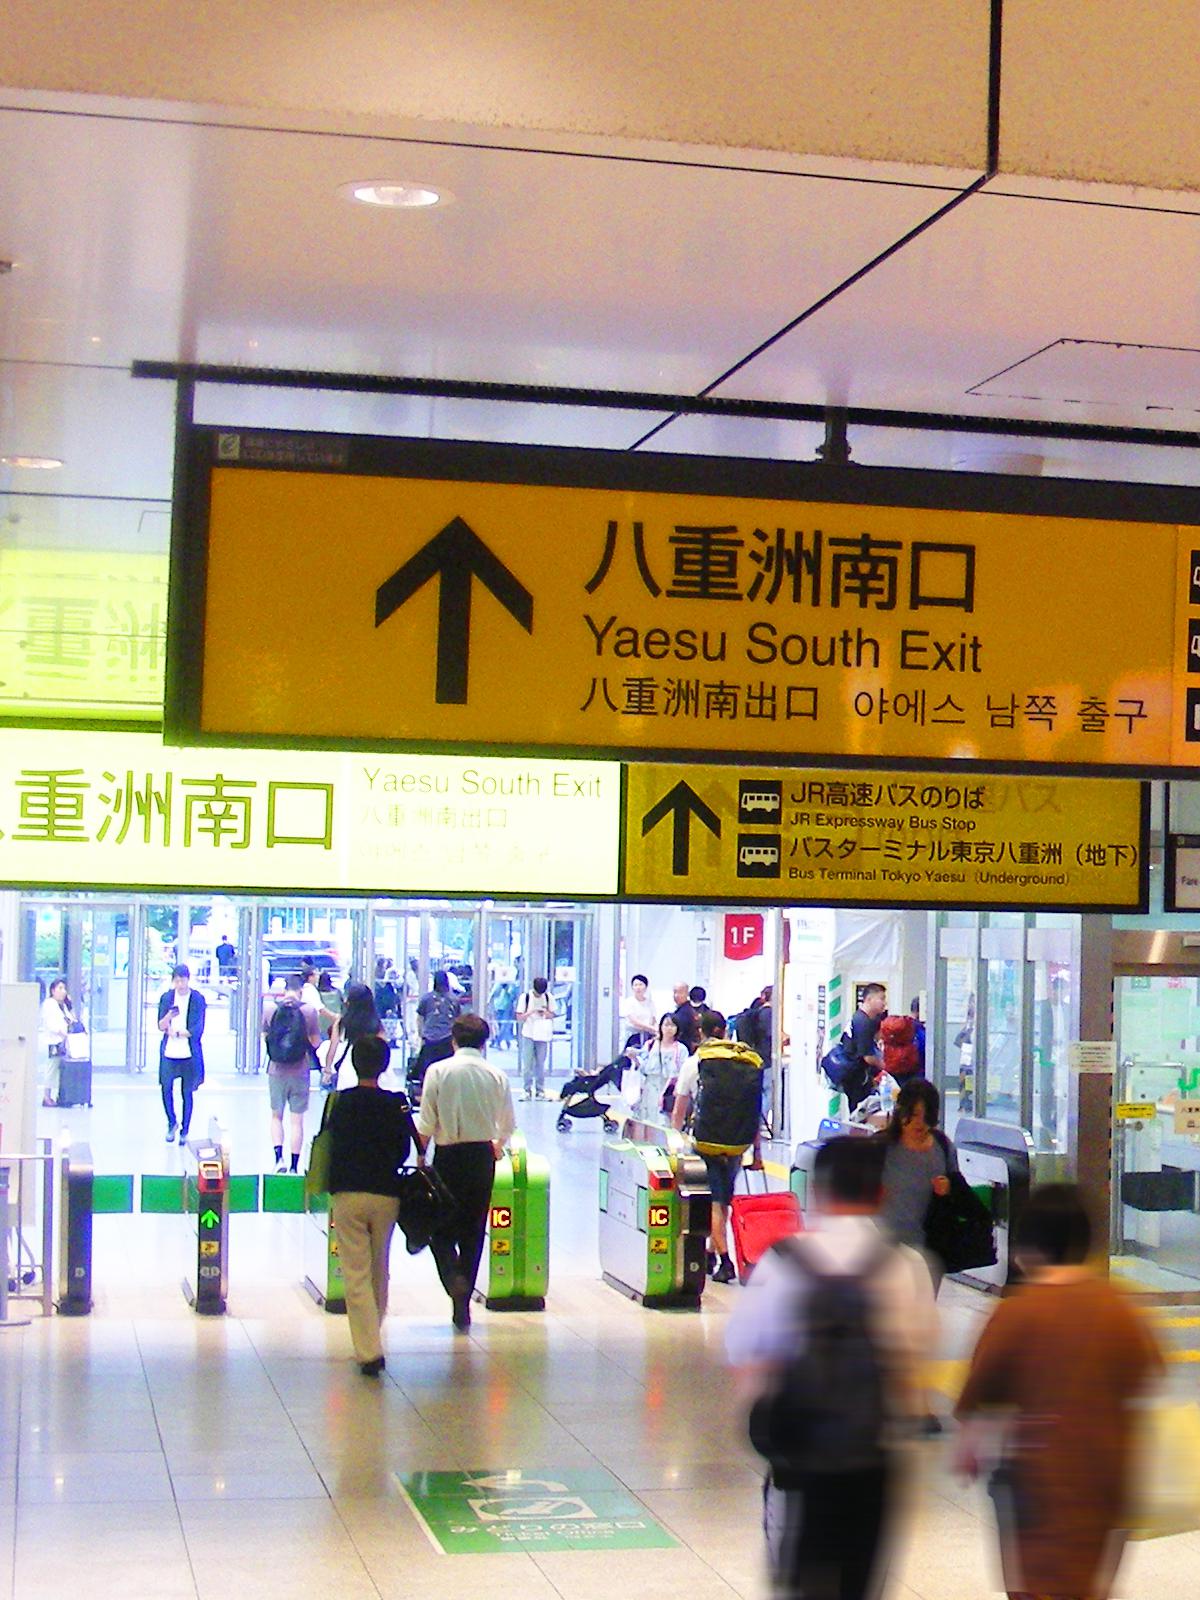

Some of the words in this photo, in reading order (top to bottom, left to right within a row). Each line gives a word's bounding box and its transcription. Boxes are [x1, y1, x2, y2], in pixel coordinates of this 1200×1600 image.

[584, 520, 976, 613] 八重洲南口
[583, 614, 726, 661] Yaesu
[747, 622, 880, 668] South
[900, 630, 982, 673] Exit
[580, 677, 819, 721] 八重洲南出口
[854, 689, 966, 727] 야에스
[986, 693, 1059, 732] 남쪽
[1077, 695, 1148, 734] 출구
[364, 768, 449, 794] Yaesu
[462, 769, 540, 796] South
[554, 773, 601, 798] Exit
[791, 782, 985, 809] JR高速バスのりば
[0, 769, 333, 849] 重洲南口
[790, 812, 810, 826] JR
[815, 813, 904, 830] Expressway
[909, 816, 937, 829] Bus
[942, 816, 976, 832] Stop
[789, 867, 814, 880] Bus
[819, 868, 876, 881] Terminal
[881, 869, 921, 884] Tokyo
[925, 870, 966, 883] Yaesu
[974, 872, 1069, 886] (Underground)
[731, 926, 755, 945] 1F
[492, 1209, 510, 1227] IC
[650, 1208, 668, 1225] IC
